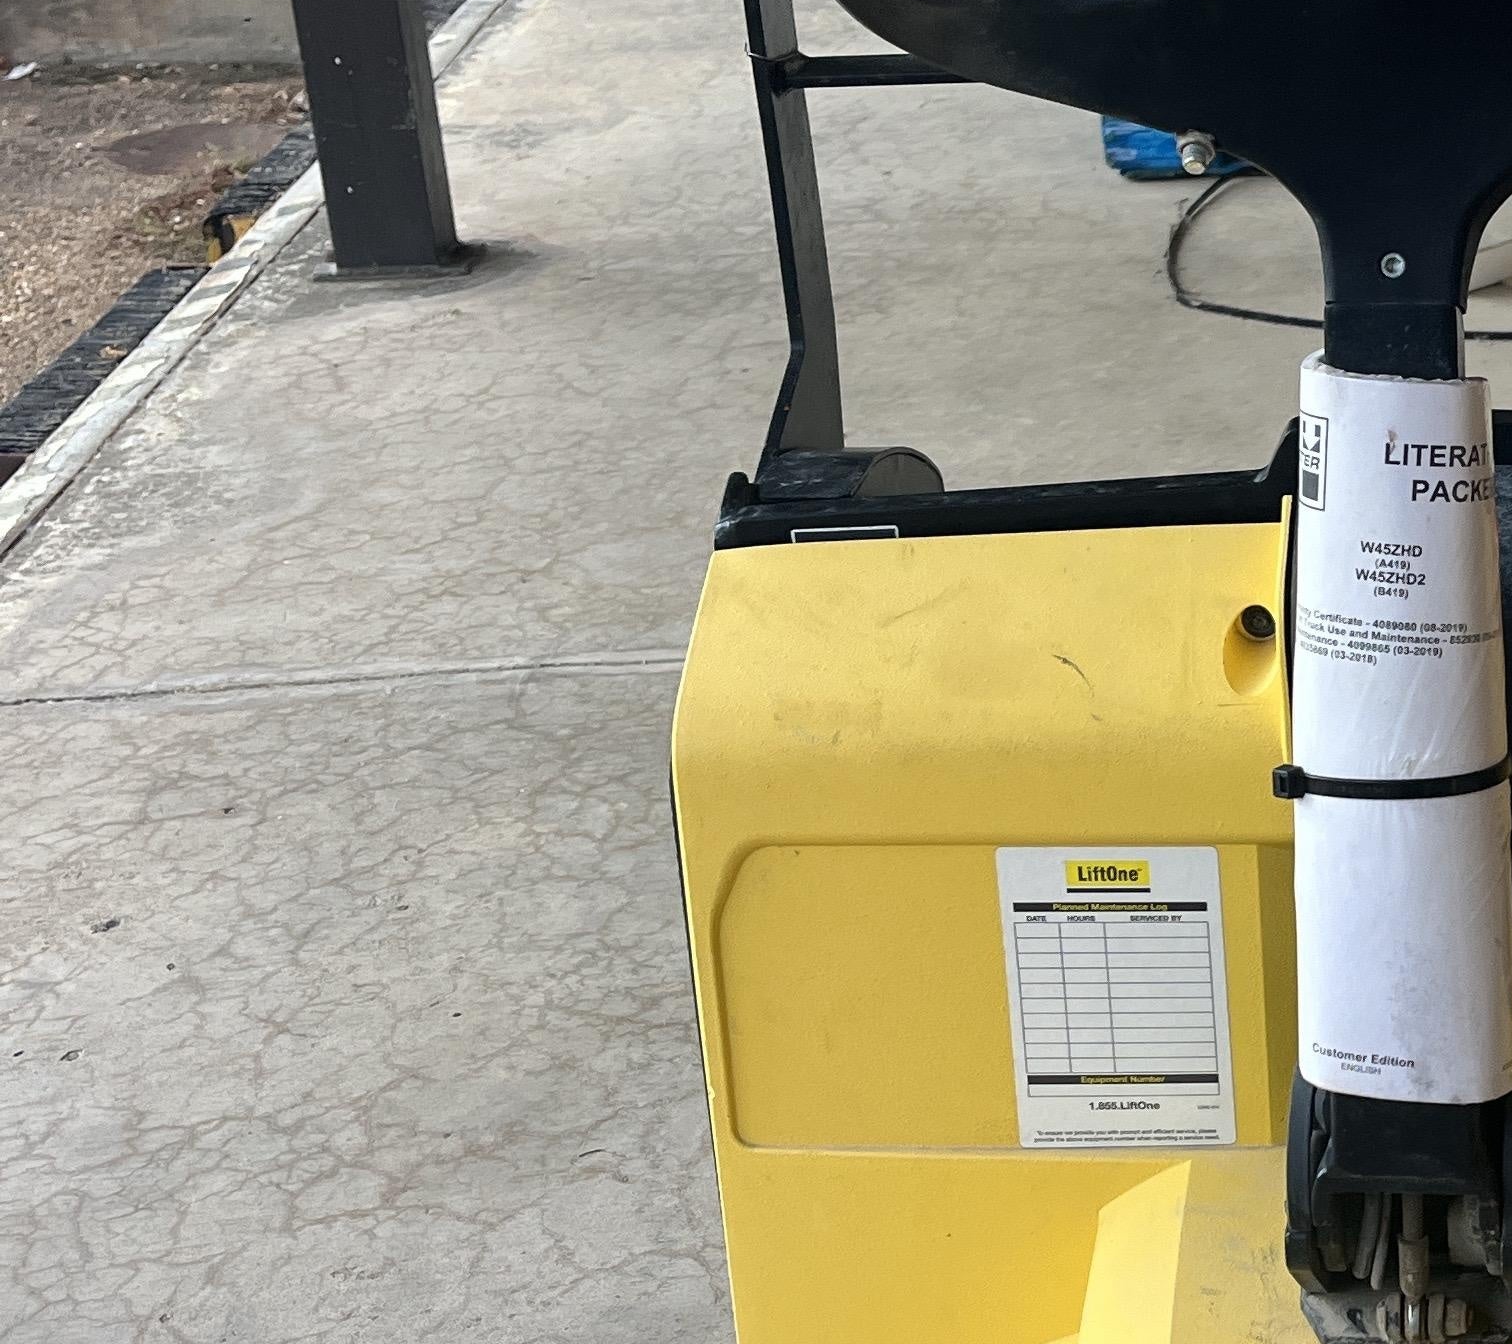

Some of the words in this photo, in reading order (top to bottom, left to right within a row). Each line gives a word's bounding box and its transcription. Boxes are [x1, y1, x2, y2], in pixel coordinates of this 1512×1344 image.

[1360, 540, 1423, 557] W45ZHD
[1374, 558, 1411, 570] (A419)
[1355, 568, 1426, 586] W45ZHD2
[1313, 610, 1363, 627] Certificate
[1327, 624, 1347, 637] Use
[1349, 629, 1369, 639] and
[1371, 630, 1440, 644] Maintenance
[1077, 865, 1139, 882] LiftOne
[1312, 1042, 1368, 1063] Customer
[1370, 1053, 1415, 1068] Edition
